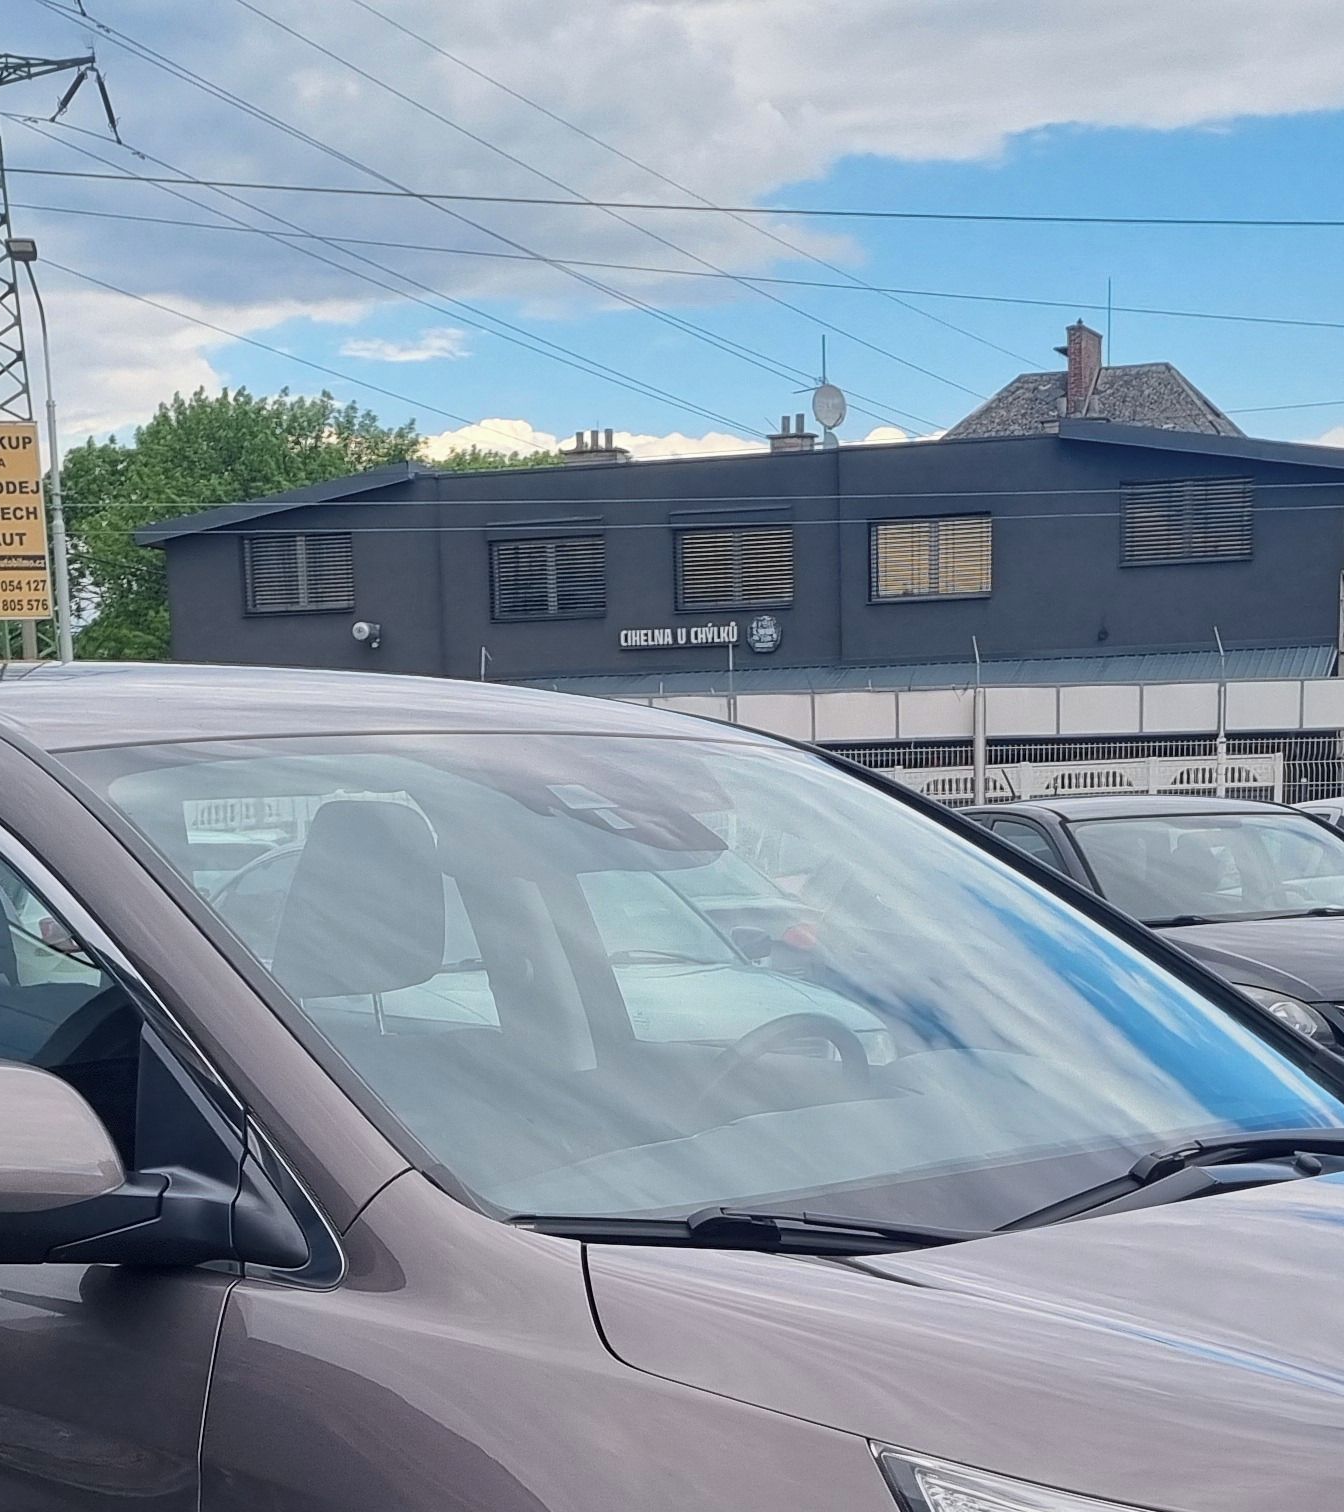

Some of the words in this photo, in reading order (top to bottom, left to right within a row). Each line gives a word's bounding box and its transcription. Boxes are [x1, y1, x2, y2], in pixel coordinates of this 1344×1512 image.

[0, 580, 23, 592] 054
[26, 580, 47, 592] 127
[2, 599, 24, 611] 805
[27, 599, 49, 611] 576
[620, 628, 673, 647] CIHELNA
[677, 627, 686, 644] U
[690, 621, 738, 644] CHÝLKŮ
